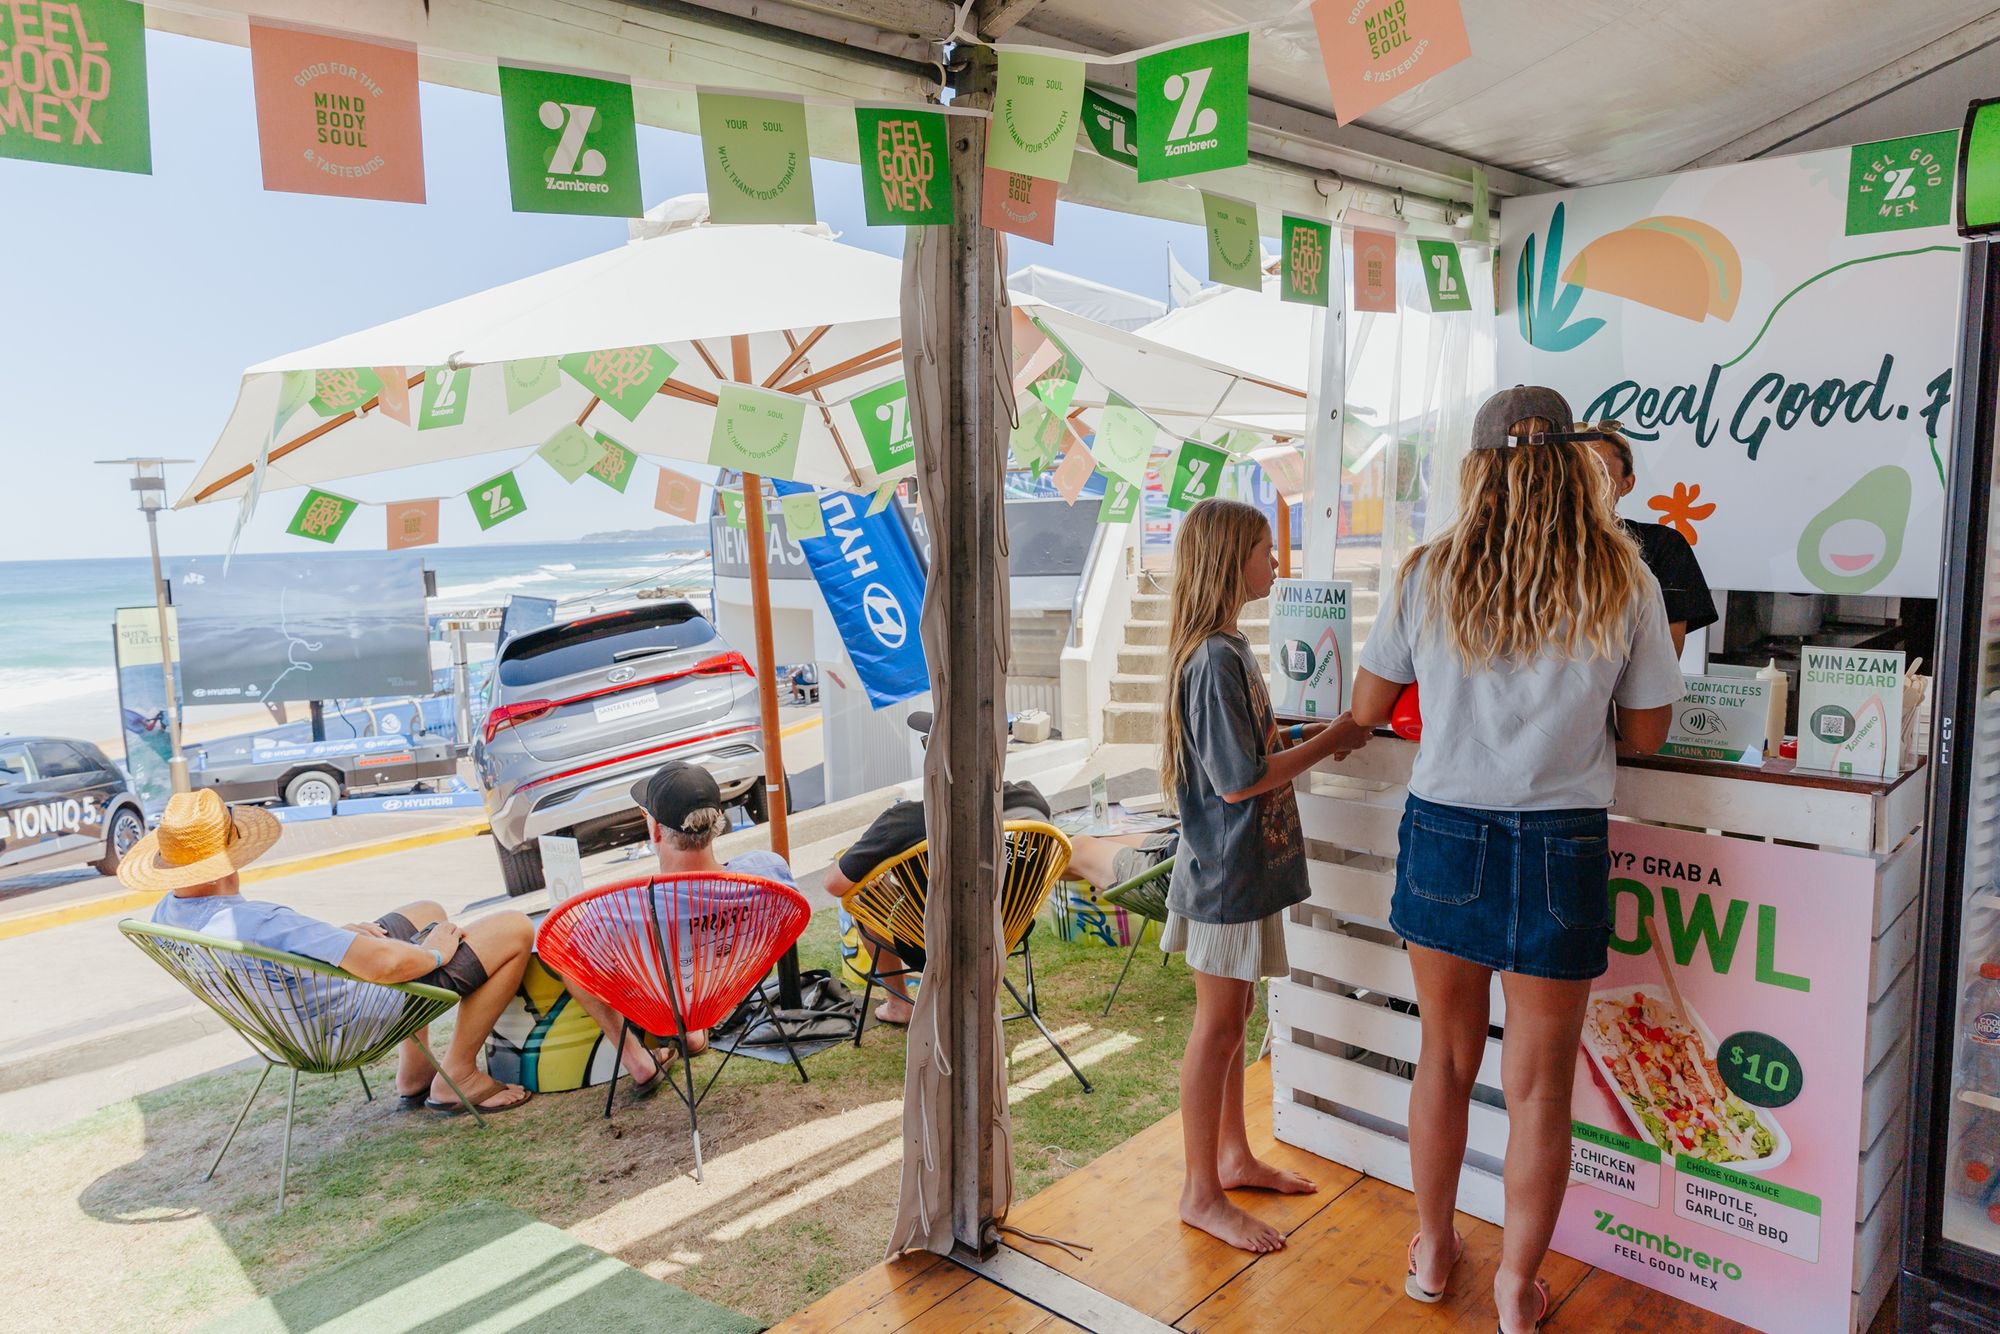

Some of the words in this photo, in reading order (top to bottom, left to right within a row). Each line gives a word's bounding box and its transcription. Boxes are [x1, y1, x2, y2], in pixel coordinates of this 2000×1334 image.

[0, 0, 108, 52] EEL
[1348, 0, 1371, 24] GOO
[1365, 0, 1405, 32] MIND
[1368, 12, 1407, 46] BODY
[1371, 29, 1412, 60] SOUL
[1374, 39, 1429, 82] TASTEBUDS
[293, 62, 328, 88] GOOD
[330, 62, 359, 80] FOR
[359, 72, 384, 98] THE
[1016, 75, 1035, 87] YOUR
[1046, 79, 1064, 91] SOUL
[314, 91, 366, 113] MIND
[1005, 98, 1013, 123] WILL
[316, 109, 367, 130] BODY
[725, 119, 748, 130] YOUR
[762, 121, 784, 133] SOUL
[1043, 110, 1069, 149] STOMACH
[317, 127, 368, 148] SOUL
[878, 120, 932, 152] FEEL
[1008, 122, 1025, 149] THANK
[1025, 143, 1043, 153] YOUR
[1164, 139, 1218, 157] Zambrero
[314, 155, 385, 178] TASTEBUDS
[718, 145, 730, 173] WILL
[729, 171, 756, 198] THANK
[755, 188, 779, 201] YOUR
[777, 152, 796, 193] STOMACH
[879, 150, 934, 182] GOOD
[1860, 154, 1895, 193] FEEL
[1909, 148, 1942, 187] GOOD
[545, 177, 609, 193] Zambrero
[881, 179, 933, 212] MEX
[1008, 188, 1031, 204] SOUL
[1009, 176, 1032, 192] BODY
[1878, 199, 1919, 217] MEX
[1292, 226, 1323, 252] FEEL
[1291, 248, 1322, 274] GOOD
[1290, 270, 1318, 295] MEX
[738, 403, 756, 413] YOUR
[767, 410, 784, 420] SOUL
[1582, 363, 1722, 448] Real
[1730, 353, 1909, 461] Good.
[1274, 603, 1347, 620] SURFBOARD
[1309, 649, 1334, 690] Zambrero
[1806, 670, 1897, 689] SURFBOARD
[1680, 693, 1717, 706] MENTS
[1719, 696, 1746, 708] ONLY
[1691, 681, 1763, 697] CONTACTLESS
[1845, 714, 1879, 752] Zambrero
[1942, 717, 1952, 764] PULL
[1673, 744, 1704, 758] THANK
[1706, 748, 1724, 760] YOU
[403, 796, 453, 808] HYUNDAI
[14, 798, 81, 840] IONIQ
[82, 796, 98, 825] 5
[1643, 855, 1702, 883] GRAB
[1708, 867, 1722, 887] A
[1607, 876, 1811, 992] OWL
[1977, 1022, 2000, 1034] RIDG
[1730, 1045, 1790, 1092] $10
[1576, 1126, 1599, 1140] YOUR
[1599, 1132, 1631, 1151] FILLING
[1580, 1146, 1636, 1176] CHICKEN
[1570, 1159, 1636, 1192] EGETARIAN
[1686, 1160, 1722, 1179] CHOOSE
[1723, 1171, 1748, 1188] YOUR
[1749, 1181, 1780, 1199] SAUCE
[1686, 1182, 1758, 1218] CHIPOTLE,
[1685, 1199, 1735, 1226] GARLIC
[1737, 1216, 1755, 1231] OR
[1758, 1223, 1789, 1244] BBQ
[1594, 1209, 1743, 1281] Zambrero
[1614, 1243, 1645, 1264] FEEL
[1649, 1256, 1685, 1278] GOOD
[1690, 1271, 1718, 1291] MEX
